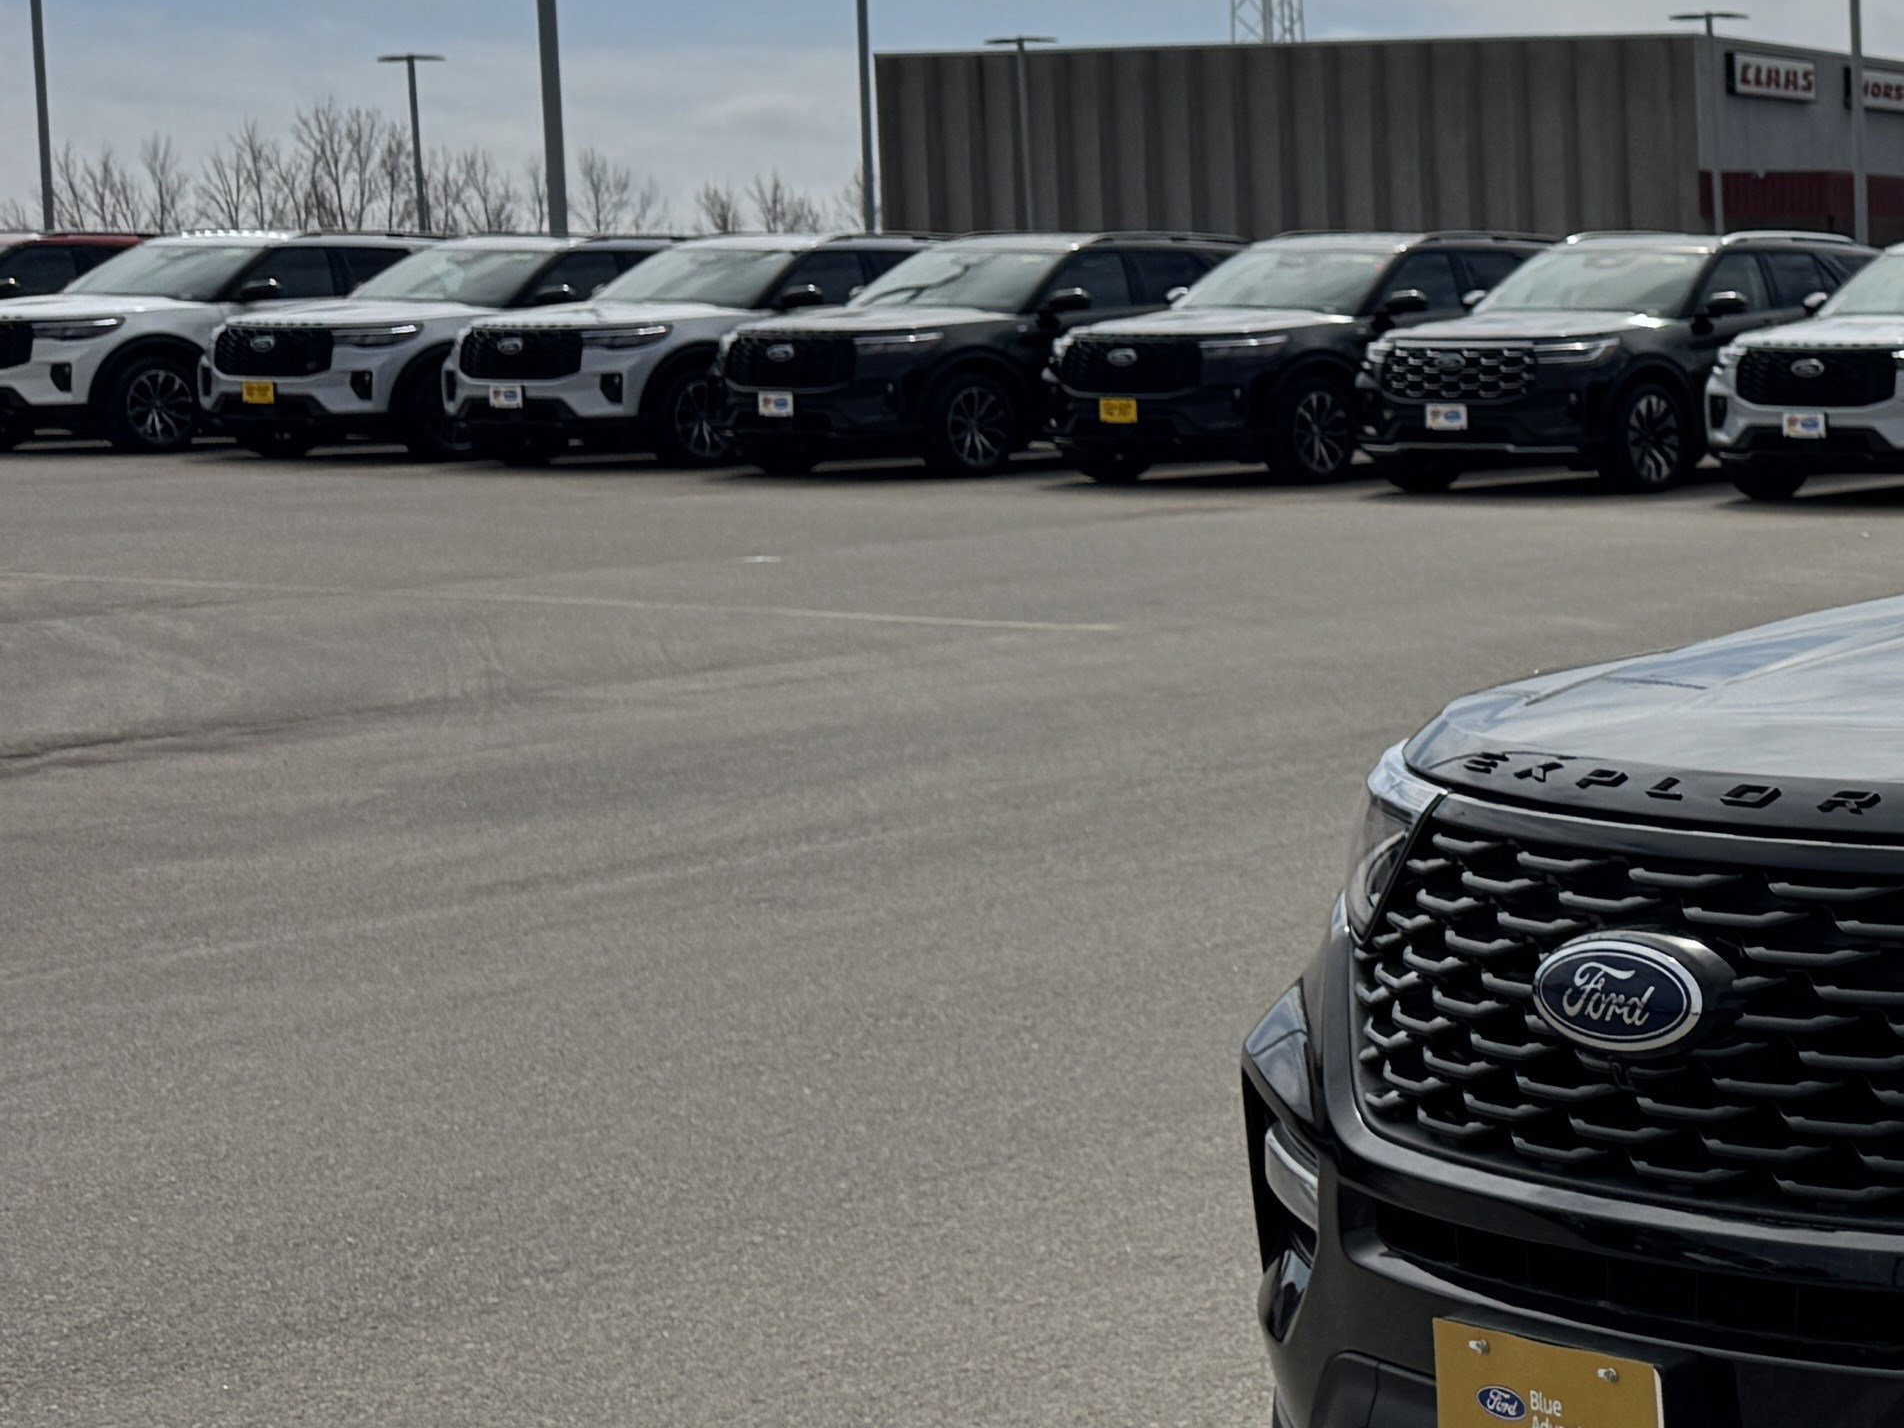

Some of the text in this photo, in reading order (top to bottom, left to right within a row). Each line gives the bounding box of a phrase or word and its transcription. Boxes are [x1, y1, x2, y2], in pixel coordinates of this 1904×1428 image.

[1740, 63, 1814, 92] CLAAS
[1562, 961, 1655, 1027] Ford
[1486, 1388, 1519, 1416] Ford
[1530, 1390, 1562, 1417] Blue
